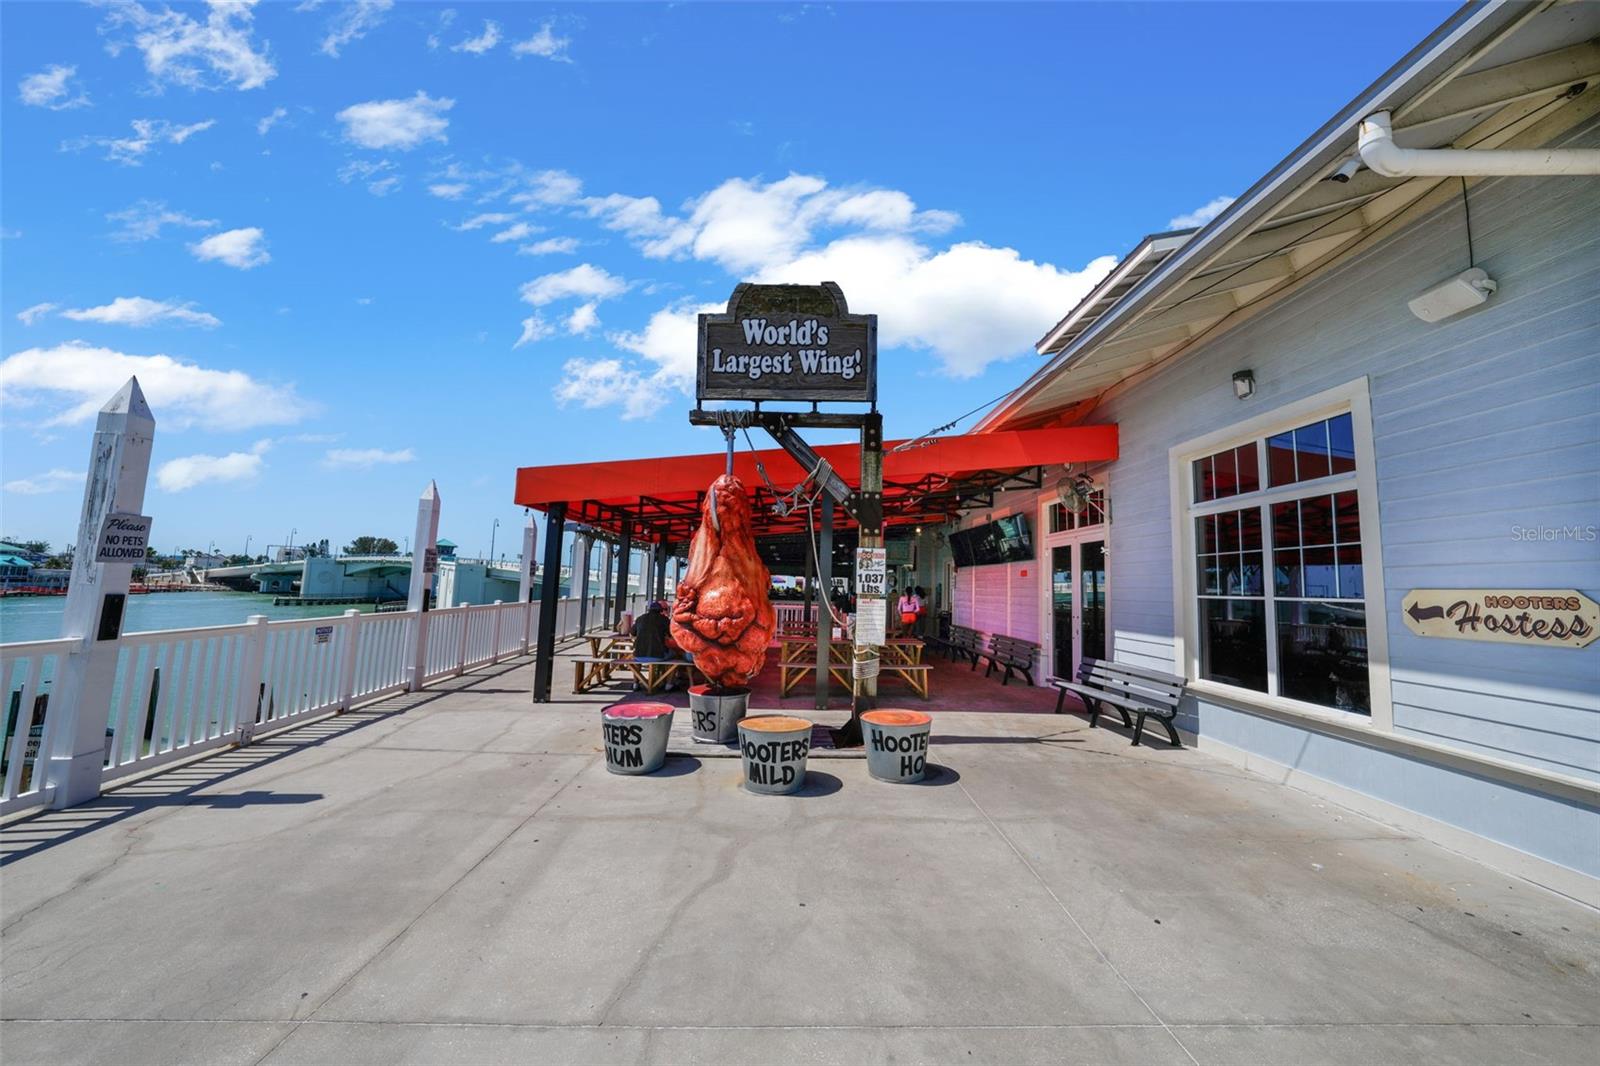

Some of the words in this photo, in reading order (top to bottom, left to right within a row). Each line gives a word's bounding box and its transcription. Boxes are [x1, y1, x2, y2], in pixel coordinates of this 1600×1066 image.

[741, 318, 829, 346] World's
[712, 348, 794, 380] Largest
[798, 348, 863, 380] Wing!
[106, 518, 146, 532] Please
[99, 546, 145, 558] ALLOWED
[105, 535, 120, 545] NO
[122, 535, 144, 546] PETS
[861, 583, 883, 594] Lbs.
[1484, 595, 1582, 611] HOOTERS
[1446, 600, 1594, 641] Hostess
[603, 724, 644, 747] TERS
[741, 733, 810, 764] HOOTERS
[749, 762, 796, 786] MILD
[900, 754, 927, 777] HO
